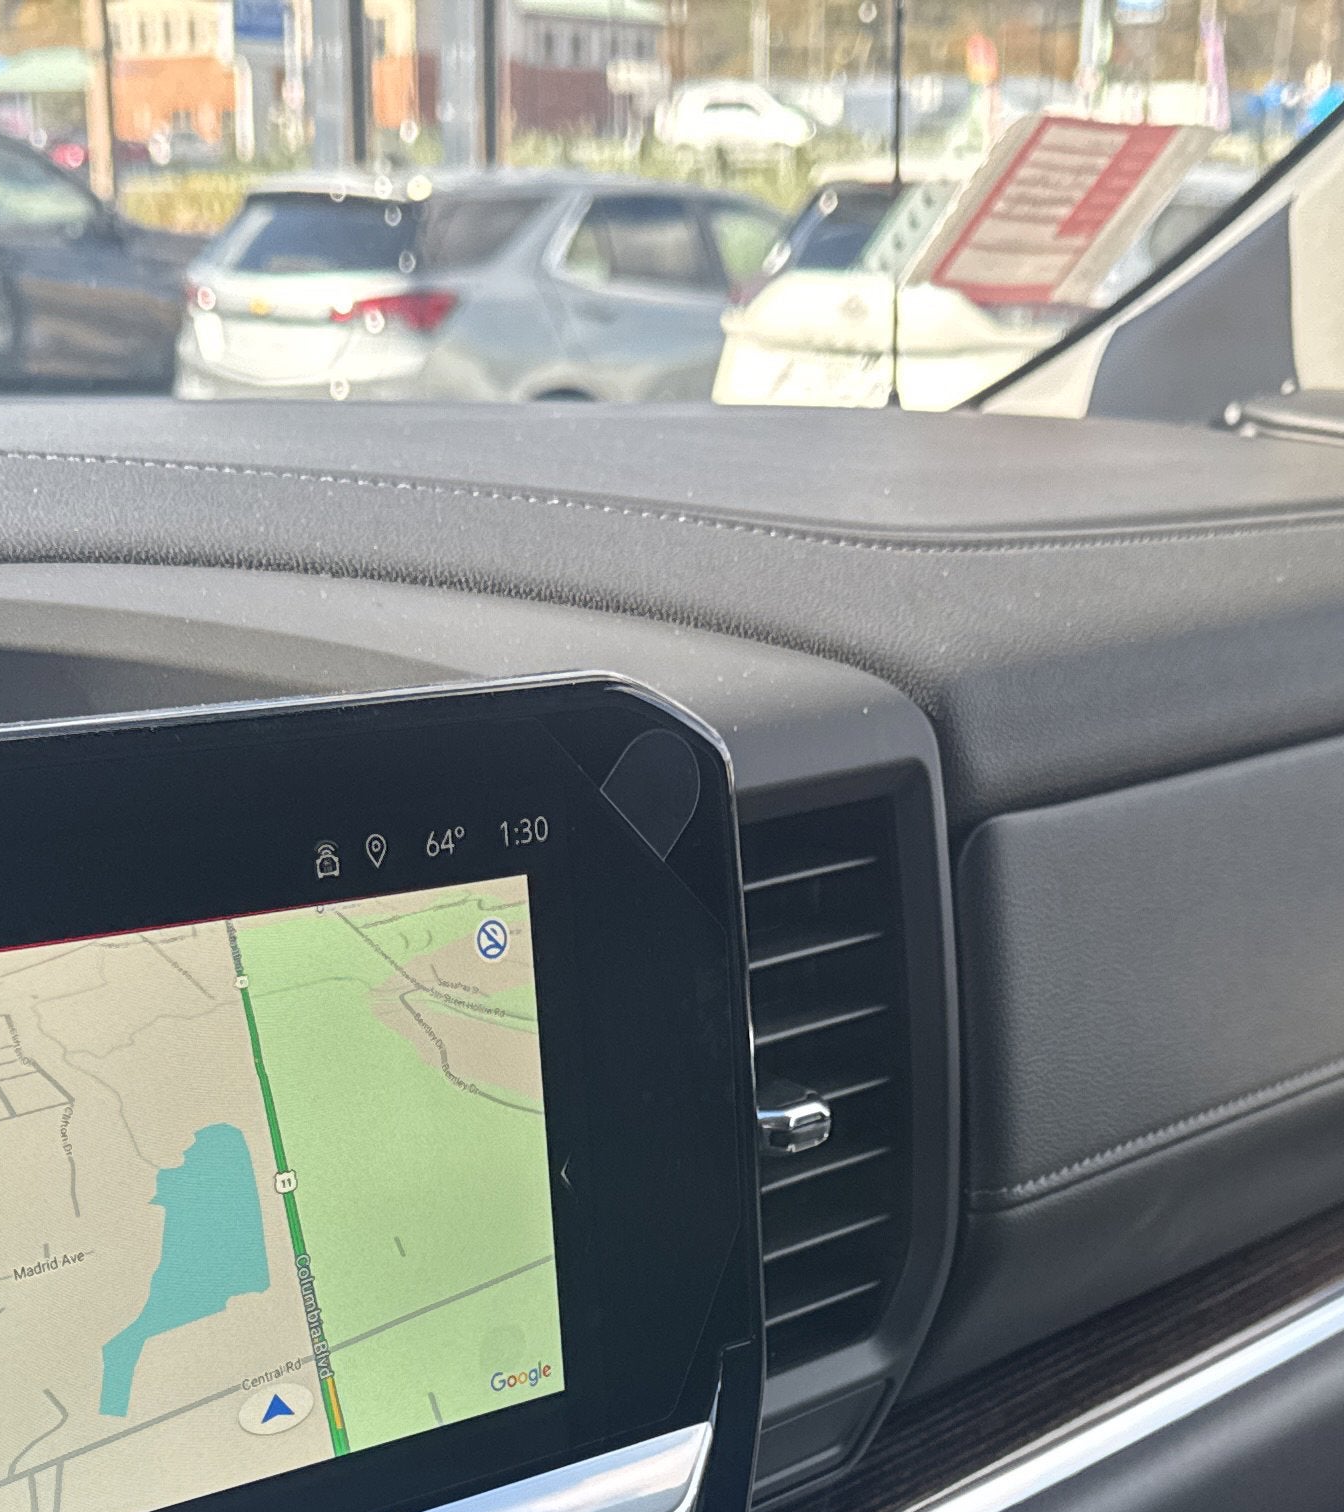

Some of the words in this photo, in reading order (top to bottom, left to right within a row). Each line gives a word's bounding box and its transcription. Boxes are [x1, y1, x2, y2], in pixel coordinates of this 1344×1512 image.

[426, 826, 465, 857] 64°
[500, 816, 549, 847] 1:30
[13, 1257, 60, 1281] Madrid
[62, 1250, 86, 1267] Ave
[295, 1253, 324, 1340] Columbia
[313, 1338, 335, 1380] Blvd
[242, 1366, 284, 1391] Central
[285, 1357, 303, 1373] Rd
[490, 1360, 553, 1392] Google
